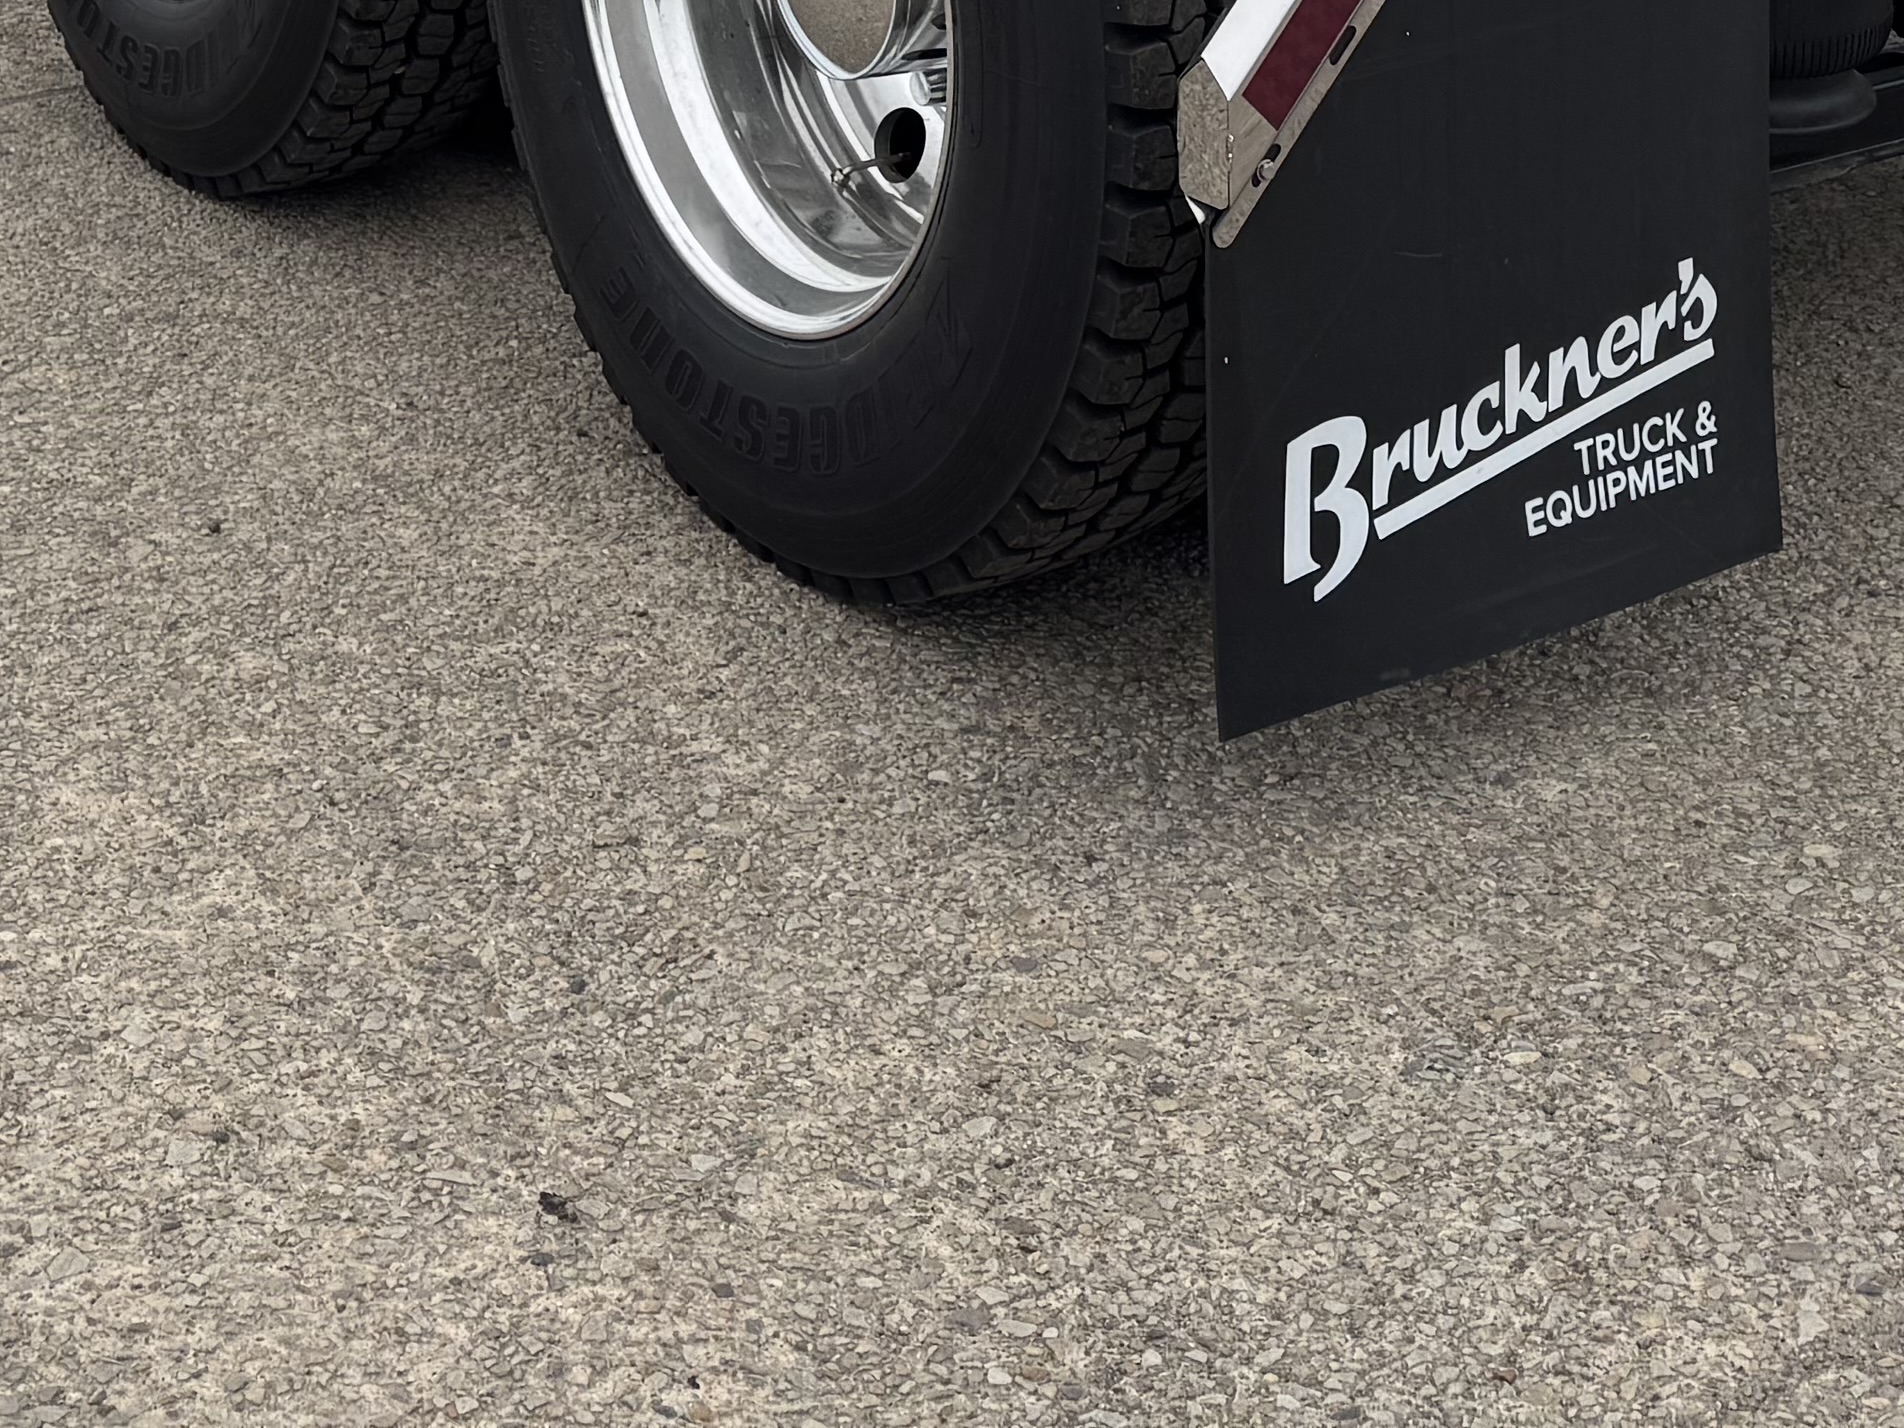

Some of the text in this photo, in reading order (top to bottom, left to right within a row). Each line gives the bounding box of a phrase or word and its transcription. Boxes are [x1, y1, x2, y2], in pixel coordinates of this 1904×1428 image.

[1283, 257, 1718, 603] Bruckner's
[1573, 400, 1718, 476] TRUCK &
[1523, 438, 1718, 538] EQUIPMENT
